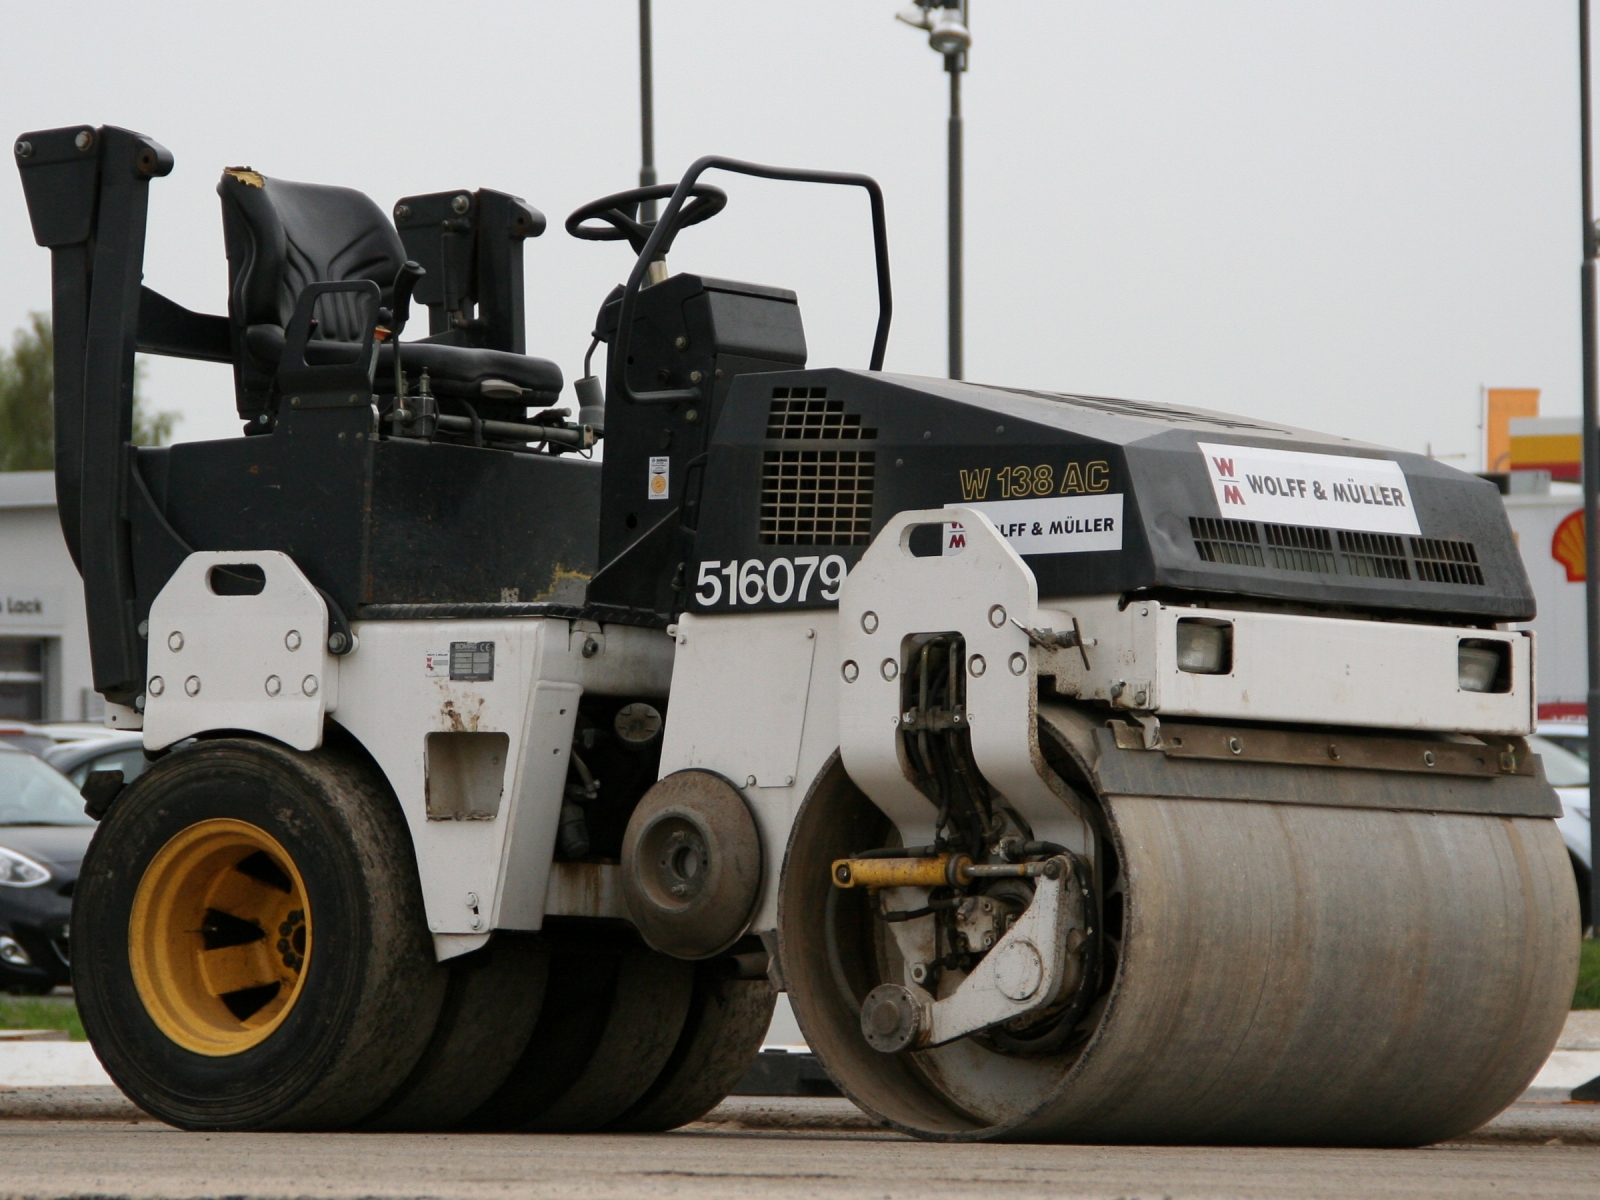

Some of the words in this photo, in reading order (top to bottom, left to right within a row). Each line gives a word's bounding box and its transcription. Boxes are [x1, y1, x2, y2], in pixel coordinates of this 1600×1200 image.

[960, 468, 991, 500] W
[997, 464, 1054, 498] 138
[1060, 461, 1109, 494] AC
[1212, 457, 1235, 477] W
[1224, 485, 1246, 505] M
[1246, 474, 1307, 498] WOLFF
[1313, 480, 1328, 500] &
[1333, 478, 1406, 507] MÜLLER
[994, 522, 1027, 538] LFF
[1031, 521, 1043, 536] &
[1049, 516, 1114, 535] MÜLLER
[695, 554, 847, 606] 516079
